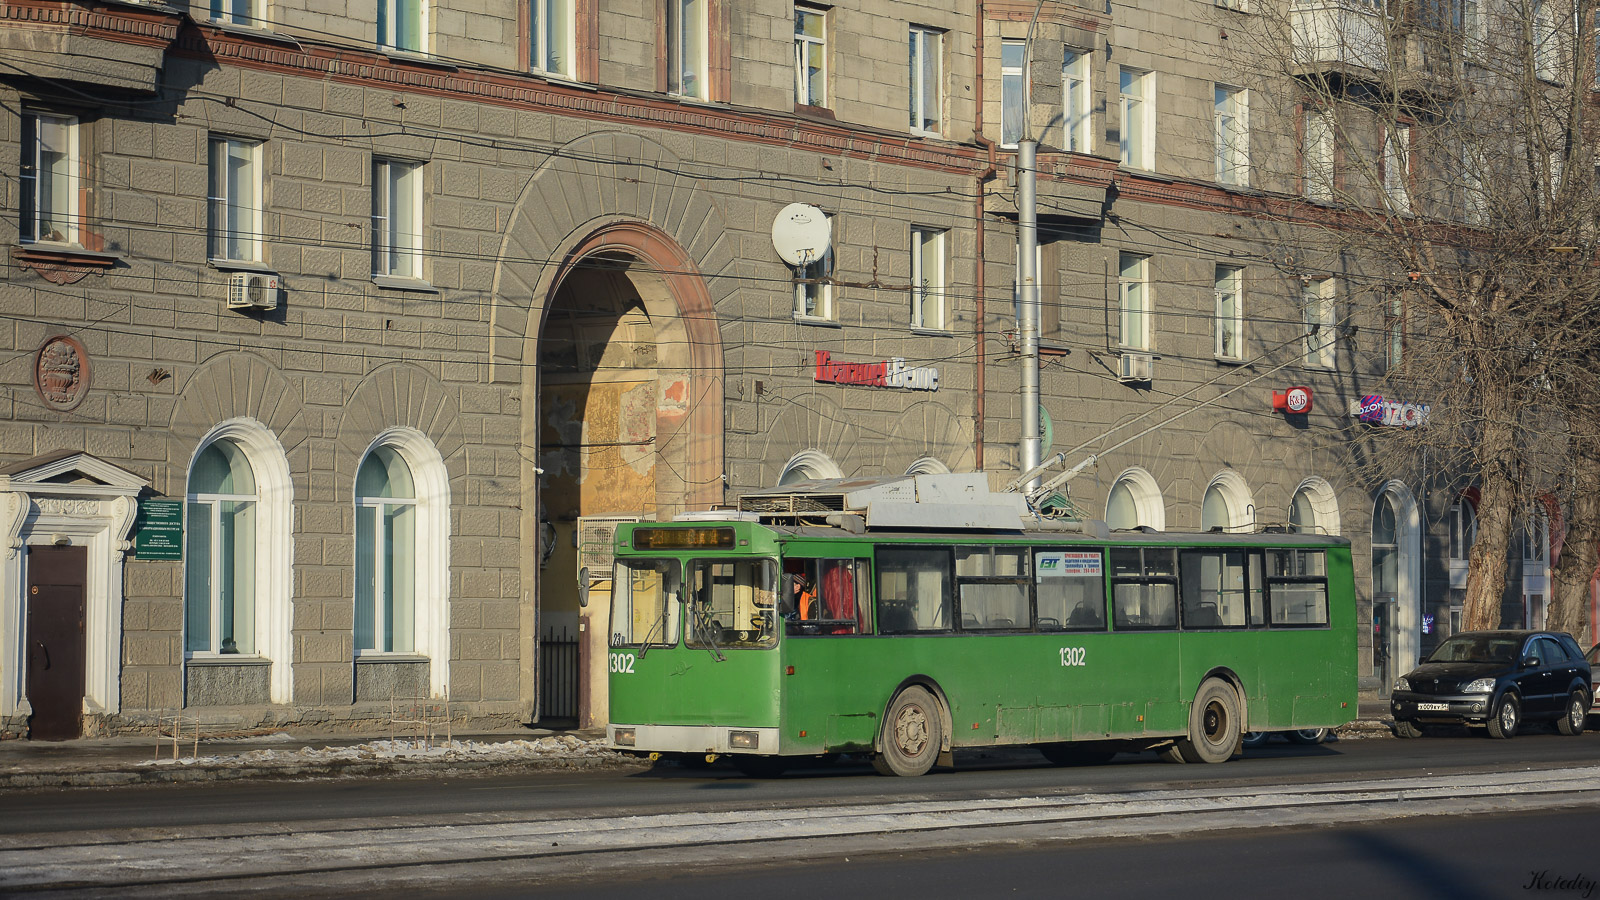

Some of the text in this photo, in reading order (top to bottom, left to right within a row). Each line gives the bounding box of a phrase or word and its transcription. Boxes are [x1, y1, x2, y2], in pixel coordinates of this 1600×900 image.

[1290, 395, 1306, 406] К&Б
[609, 653, 635, 673] 1302
[1059, 647, 1086, 666] 1302
